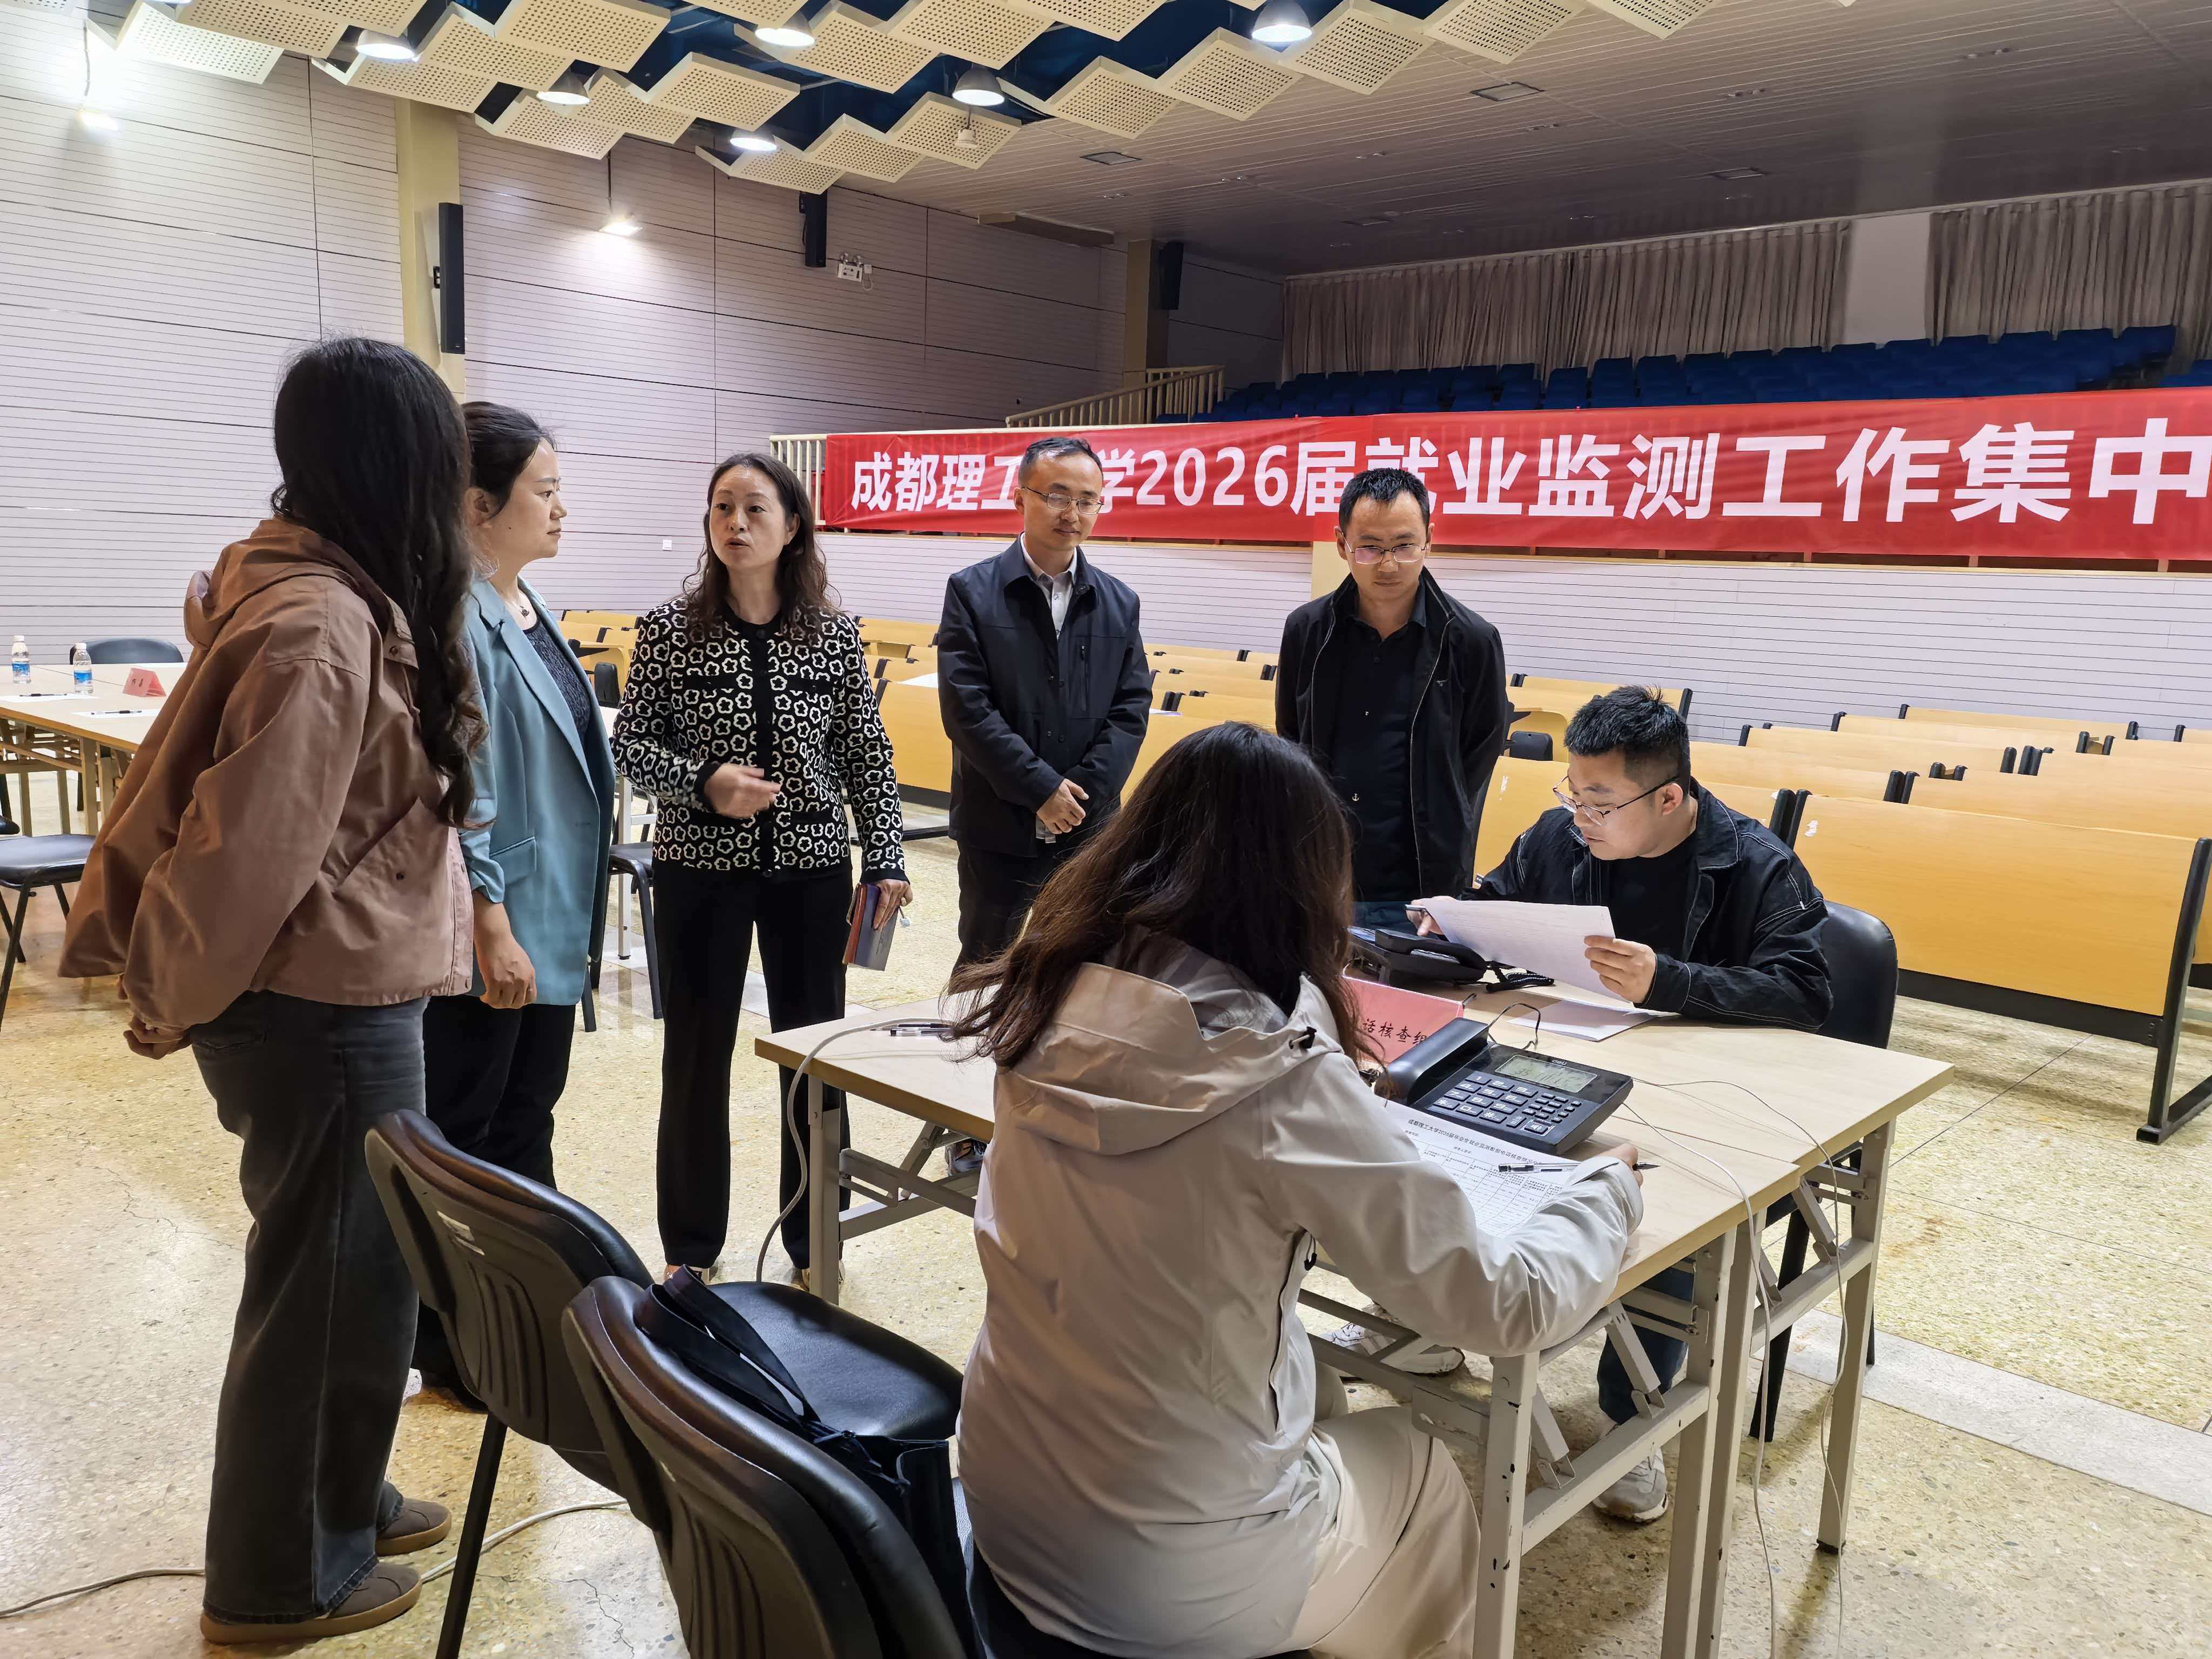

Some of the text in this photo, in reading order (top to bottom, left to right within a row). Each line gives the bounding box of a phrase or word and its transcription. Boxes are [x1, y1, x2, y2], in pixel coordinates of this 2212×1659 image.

[852, 418, 2212, 524] 成都理工学2026届就业监测工作集中
